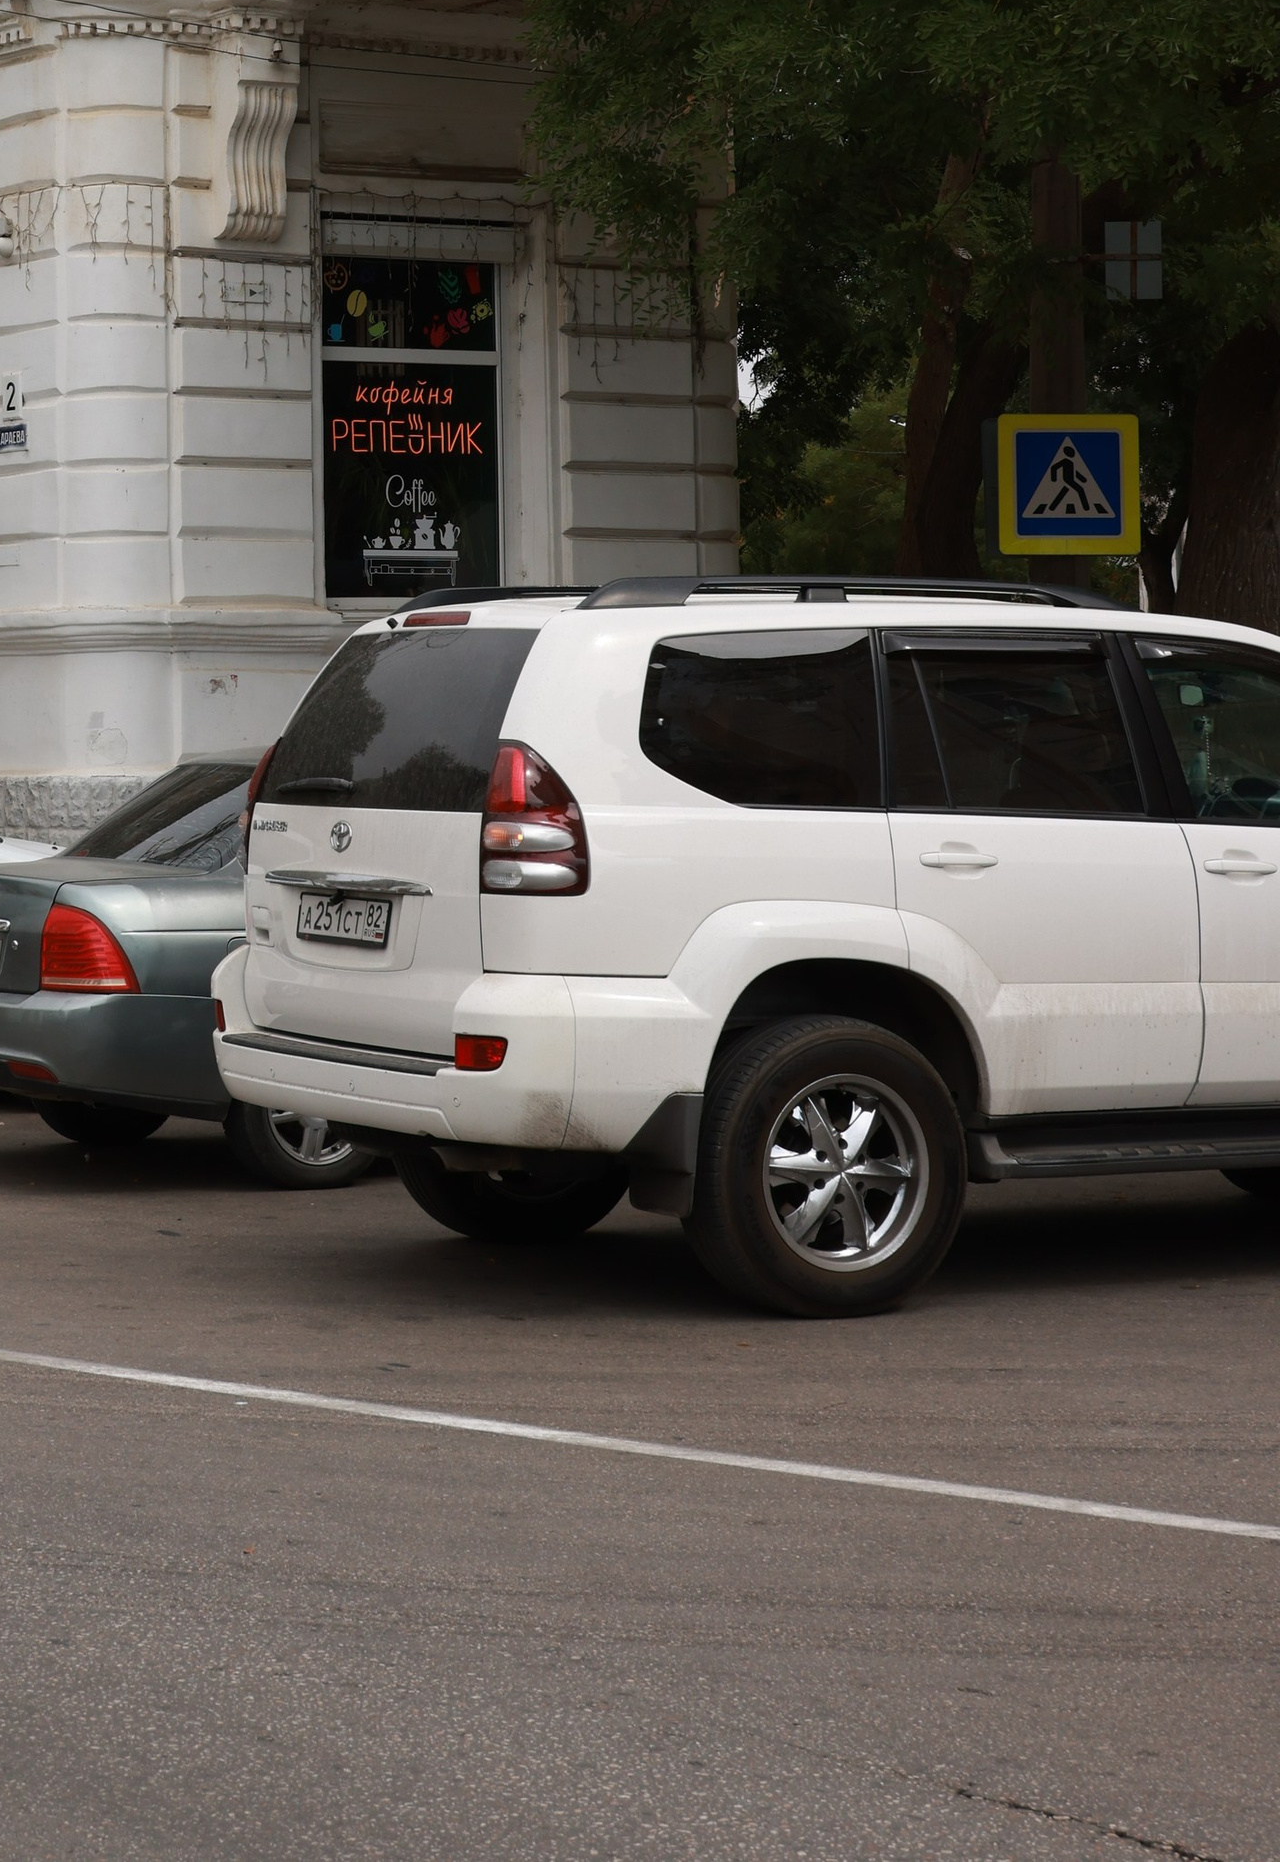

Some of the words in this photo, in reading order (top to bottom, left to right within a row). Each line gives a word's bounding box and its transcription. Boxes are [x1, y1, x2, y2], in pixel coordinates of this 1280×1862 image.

[6, 381, 16, 411] 2
[355, 380, 453, 415] кофейня
[386, 474, 437, 513] Coffee
[366, 904, 383, 928] 82
